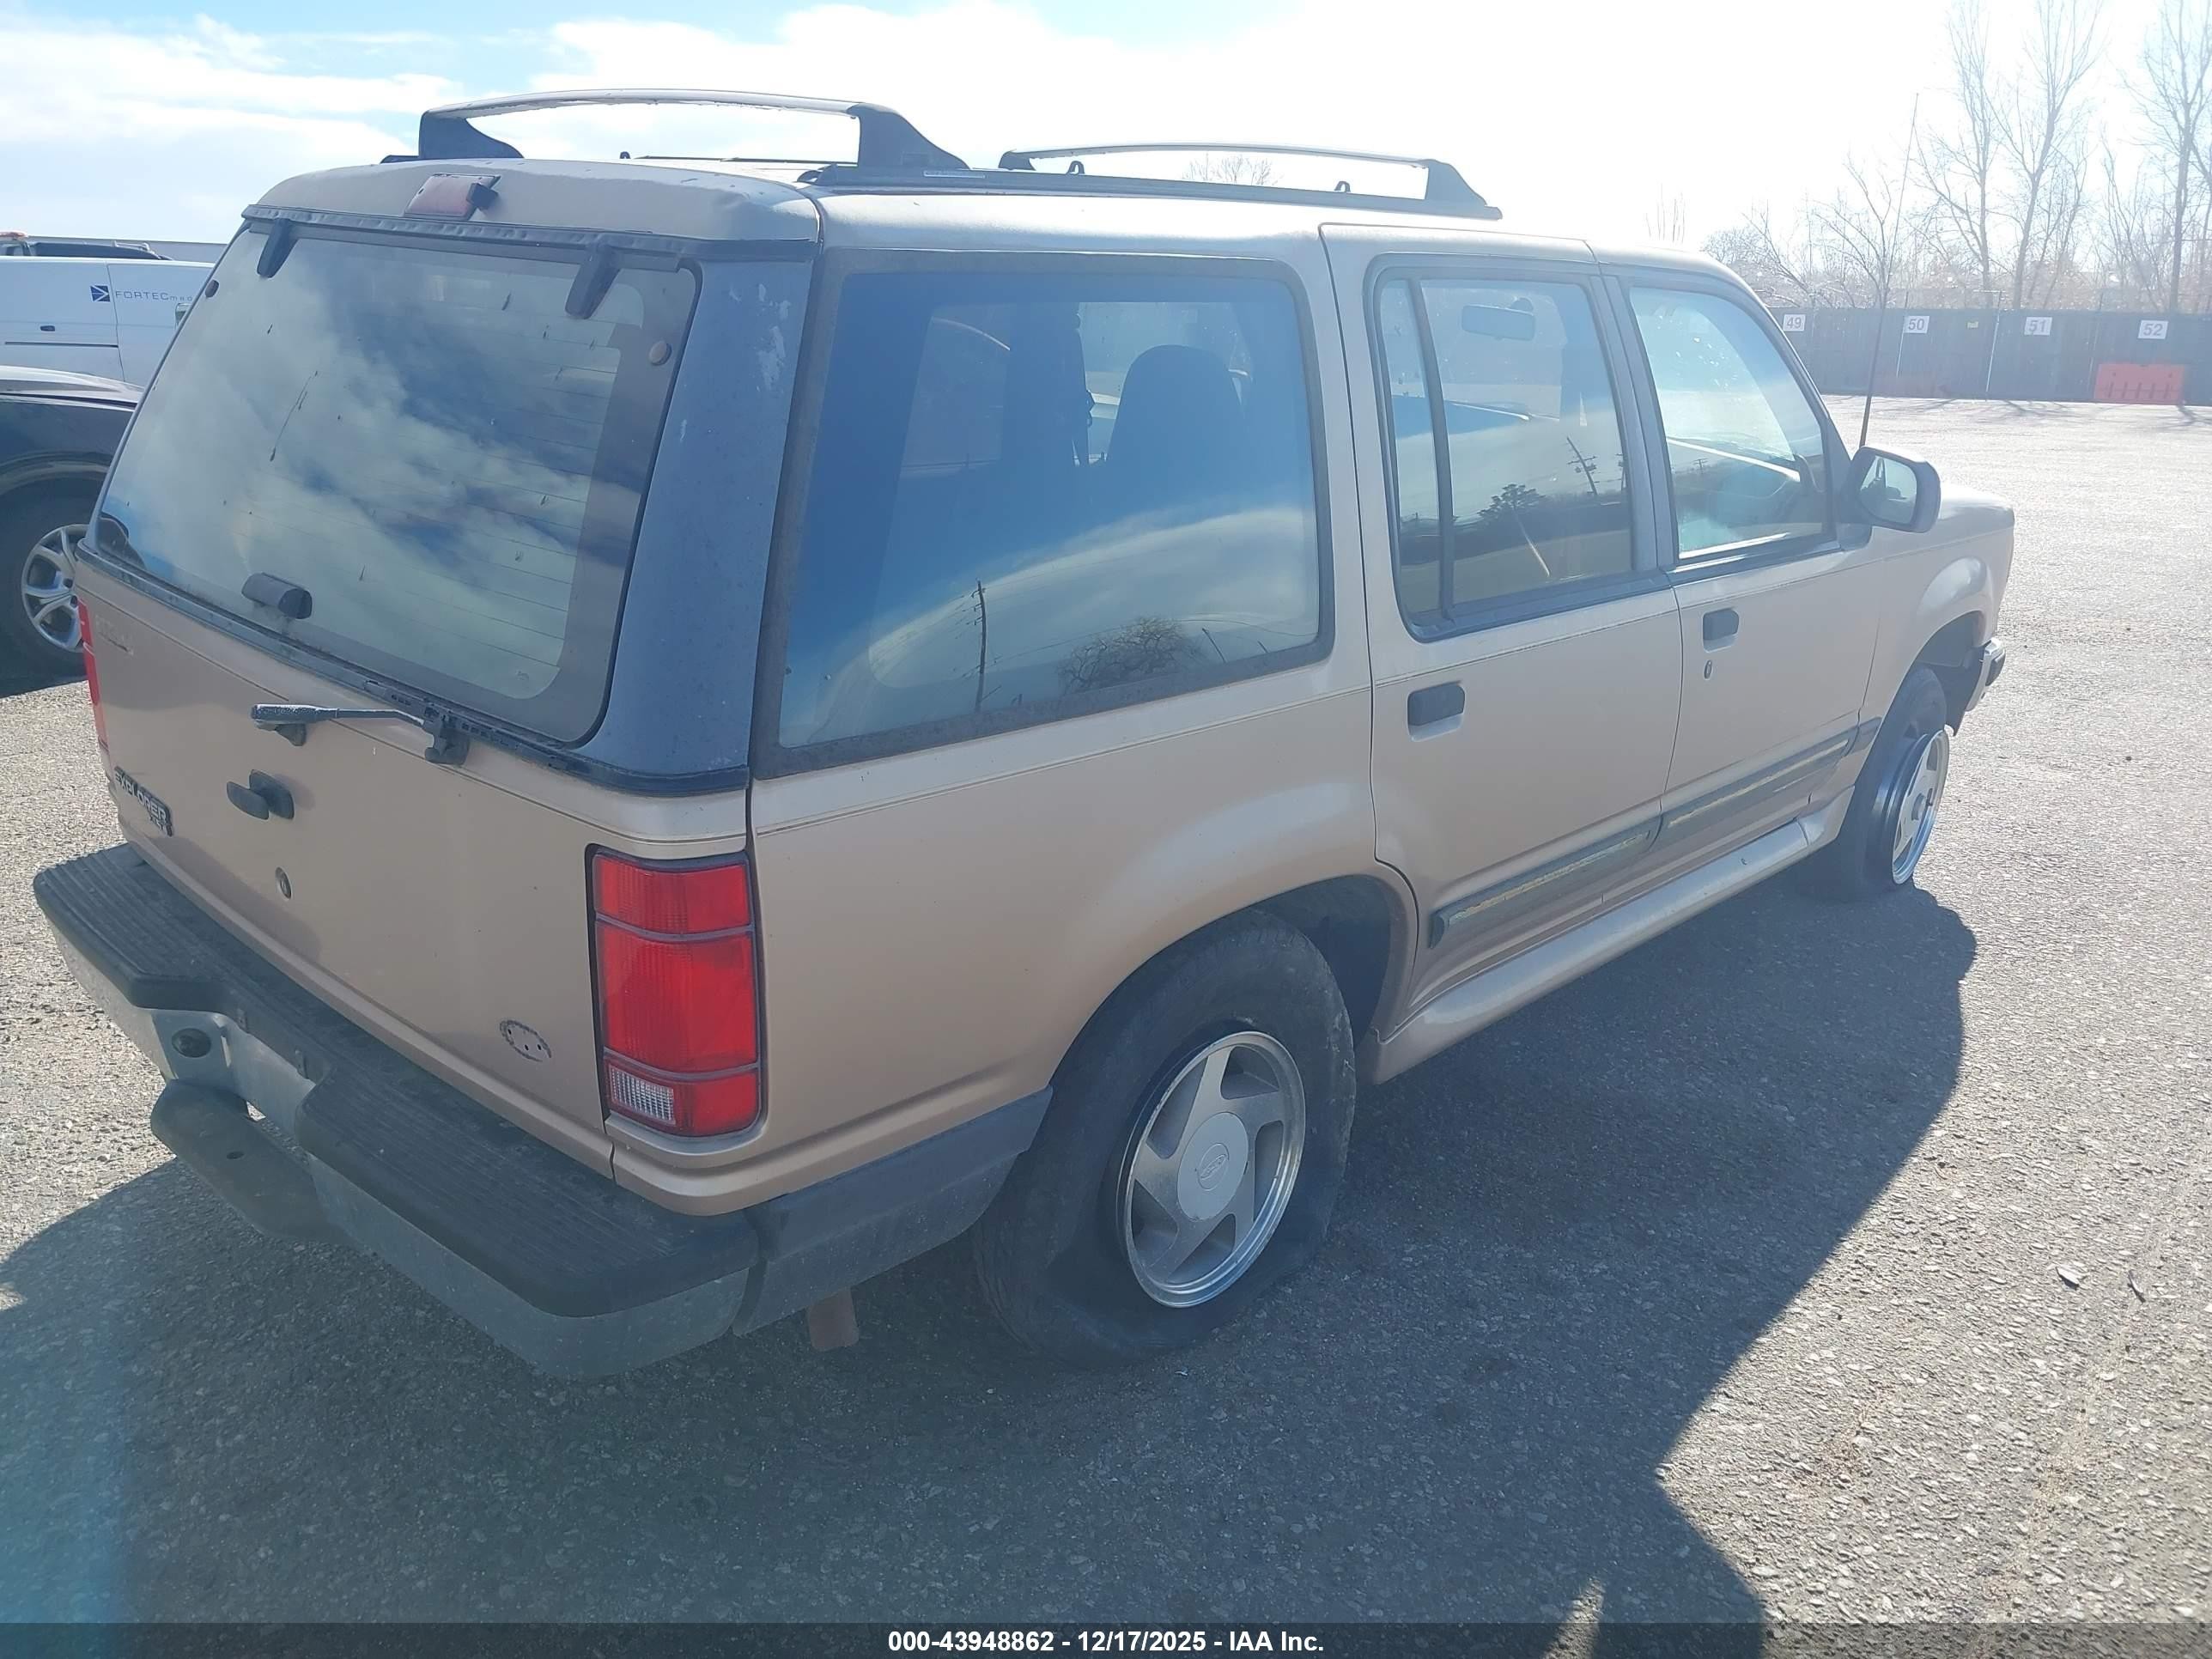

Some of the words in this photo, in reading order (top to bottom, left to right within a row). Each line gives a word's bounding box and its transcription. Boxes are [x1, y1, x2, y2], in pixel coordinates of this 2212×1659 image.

[115, 290, 169, 301] FORTEC
[1786, 317, 1802, 329] 49
[1908, 318, 1925, 331] 50
[2028, 319, 2047, 332] 51
[2142, 323, 2164, 337] 52
[114, 772, 167, 822] EXPLORER
